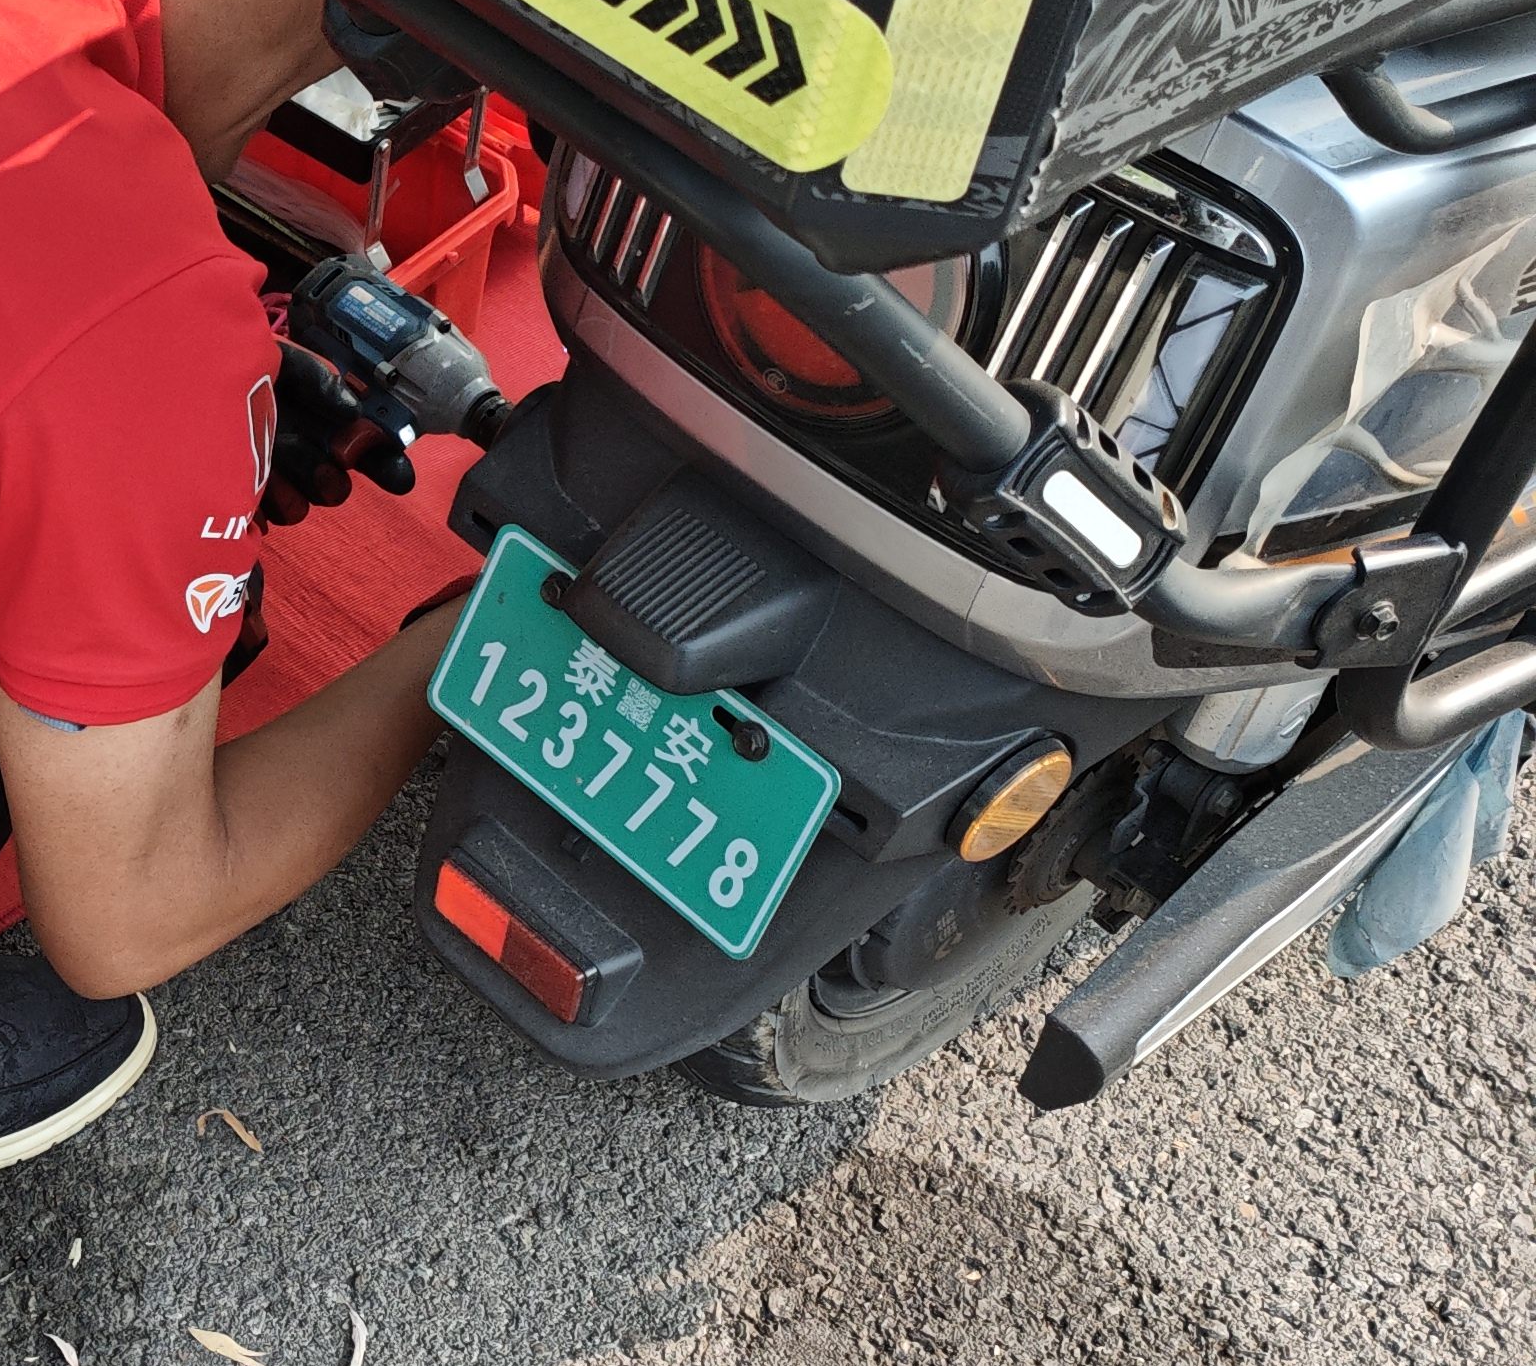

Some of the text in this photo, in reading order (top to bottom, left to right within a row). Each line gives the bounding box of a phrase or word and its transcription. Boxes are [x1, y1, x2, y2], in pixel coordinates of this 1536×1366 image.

[469, 641, 759, 908] 1237778
[564, 638, 713, 784] 泰 安
